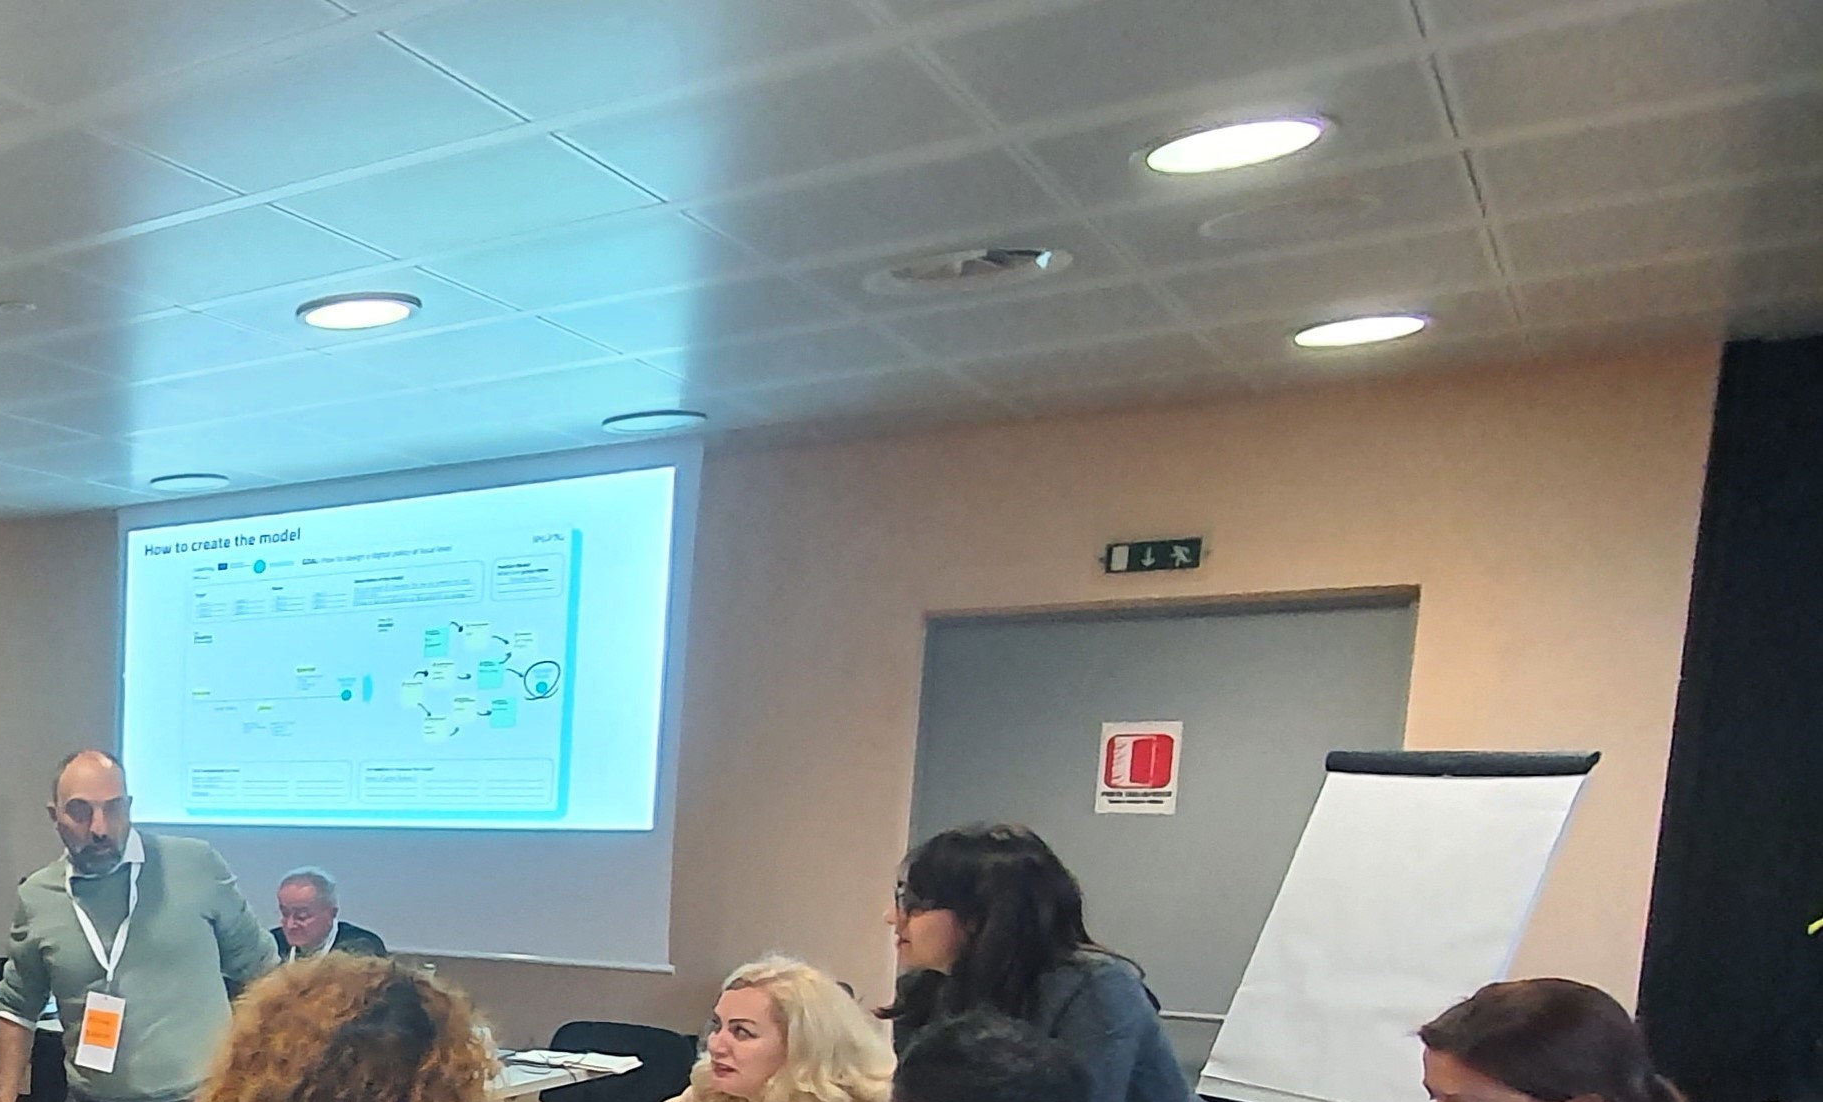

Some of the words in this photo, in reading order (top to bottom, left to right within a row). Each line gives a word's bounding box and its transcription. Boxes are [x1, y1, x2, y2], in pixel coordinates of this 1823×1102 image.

[144, 544, 172, 556] How
[175, 542, 188, 554] to
[191, 537, 231, 551] create
[234, 532, 256, 547] the
[259, 527, 301, 544] model
